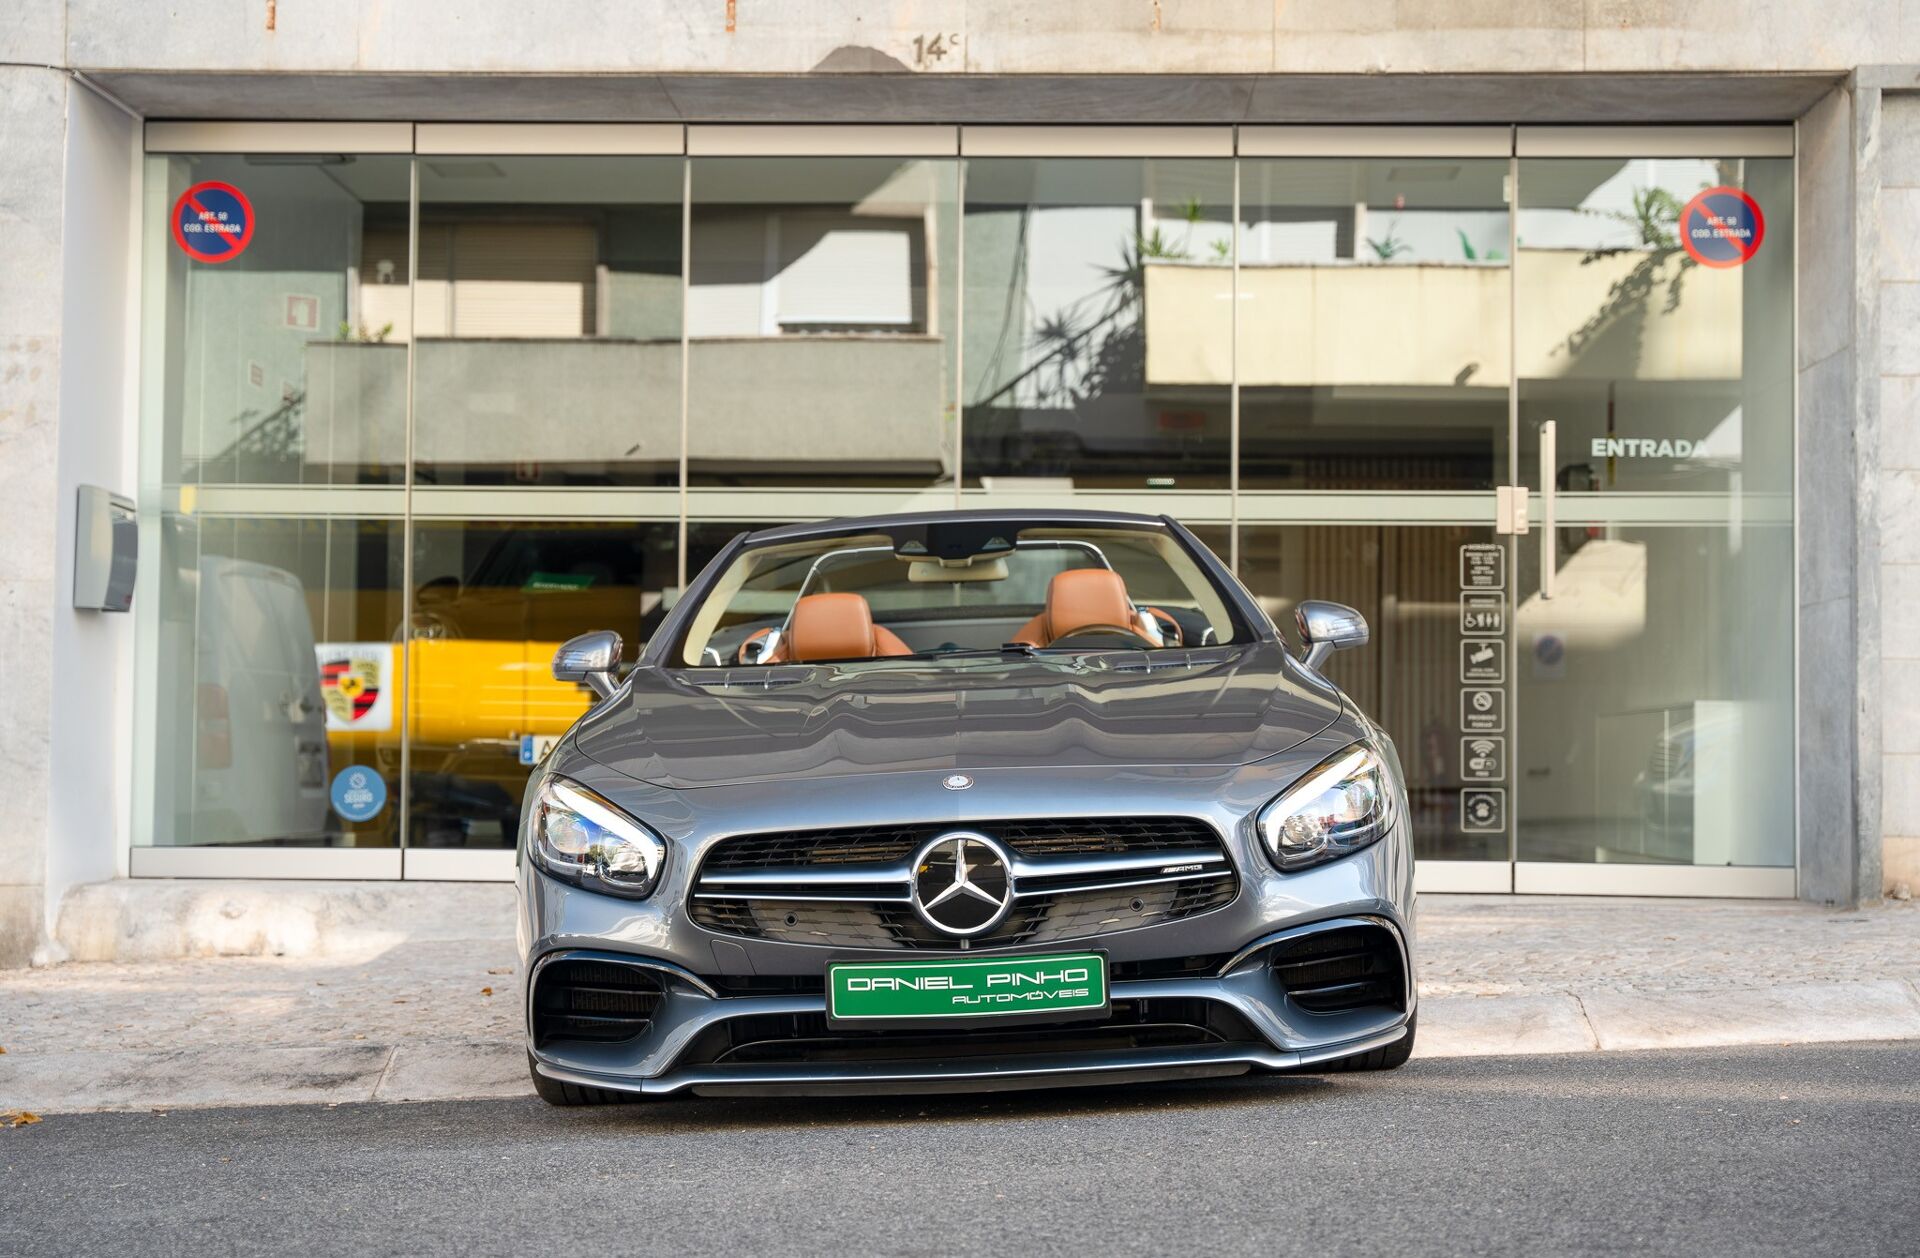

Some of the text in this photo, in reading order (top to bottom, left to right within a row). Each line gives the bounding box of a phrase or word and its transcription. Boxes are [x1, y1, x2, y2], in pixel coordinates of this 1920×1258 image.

[204, 223, 241, 233] ESTRADA
[1591, 438, 1709, 458] ENTRADA
[847, 968, 1088, 992] DANIEL PINHO
[952, 988, 1089, 1005] AUTOMÓVEIS
